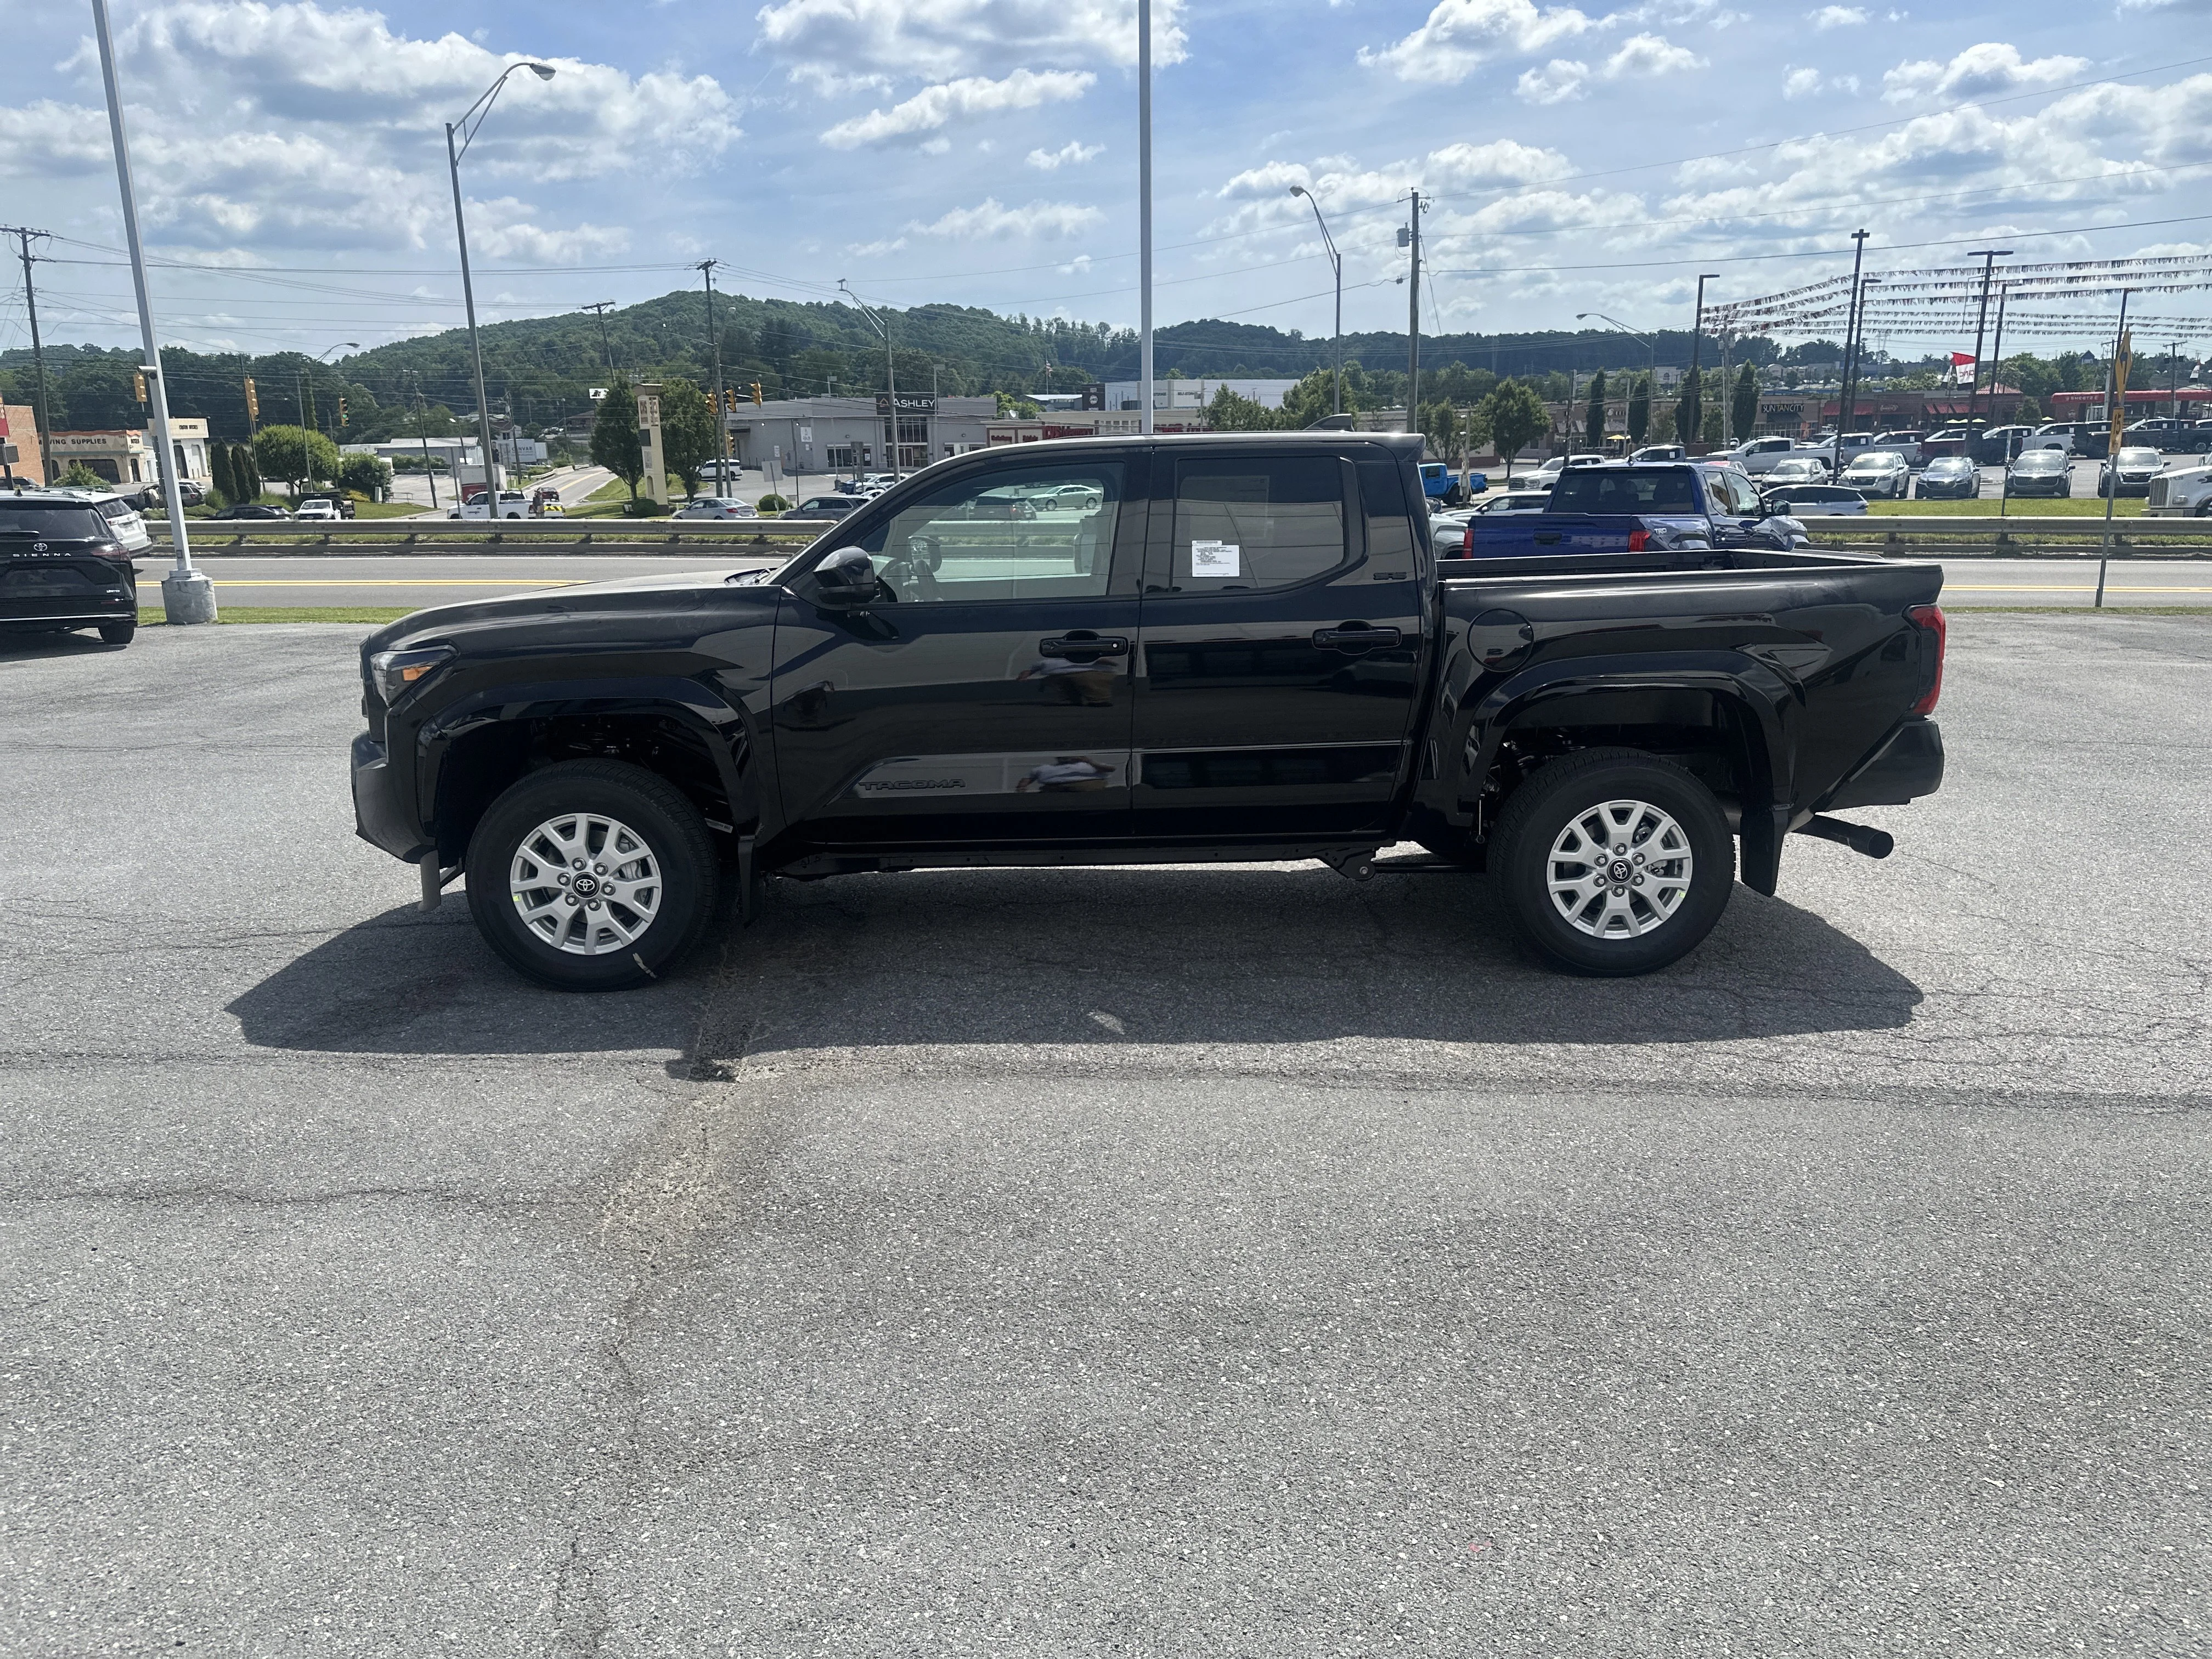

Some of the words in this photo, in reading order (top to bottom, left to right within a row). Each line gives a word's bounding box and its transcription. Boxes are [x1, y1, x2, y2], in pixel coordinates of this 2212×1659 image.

[894, 398, 935, 408] ASHLEY
[1763, 404, 1776, 413] SUN
[1789, 404, 1804, 412] CITY
[2113, 413, 2121, 435] 15
[858, 778, 966, 791] TACOMA
